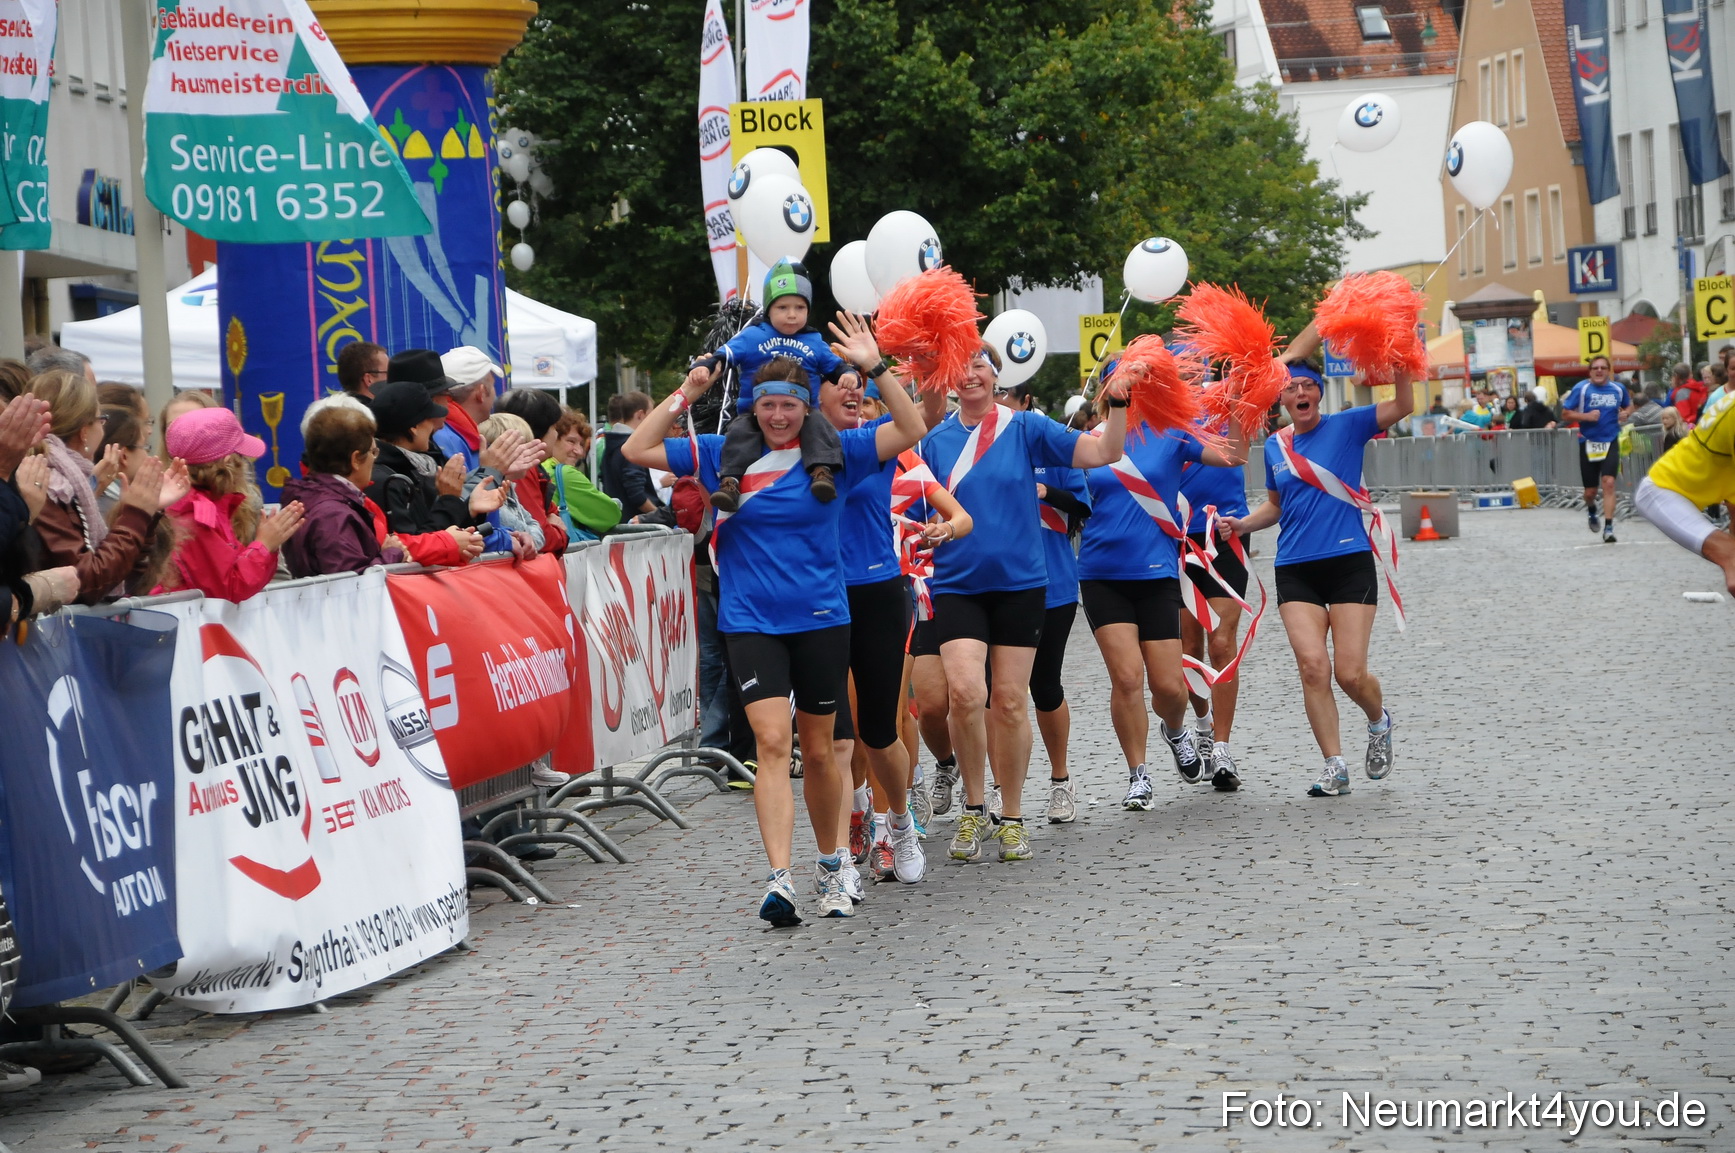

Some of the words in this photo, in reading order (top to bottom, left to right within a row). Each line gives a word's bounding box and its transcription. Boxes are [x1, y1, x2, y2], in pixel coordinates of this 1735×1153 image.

[741, 106, 813, 133] Block
[170, 182, 257, 222] 09181
[276, 181, 385, 220] 6352
[1699, 278, 1733, 292] Block
[1706, 295, 1728, 326] C
[1084, 316, 1116, 328] Block
[1582, 319, 1608, 328] Block
[758, 337, 814, 355] funrunner
[1588, 331, 1604, 353] D
